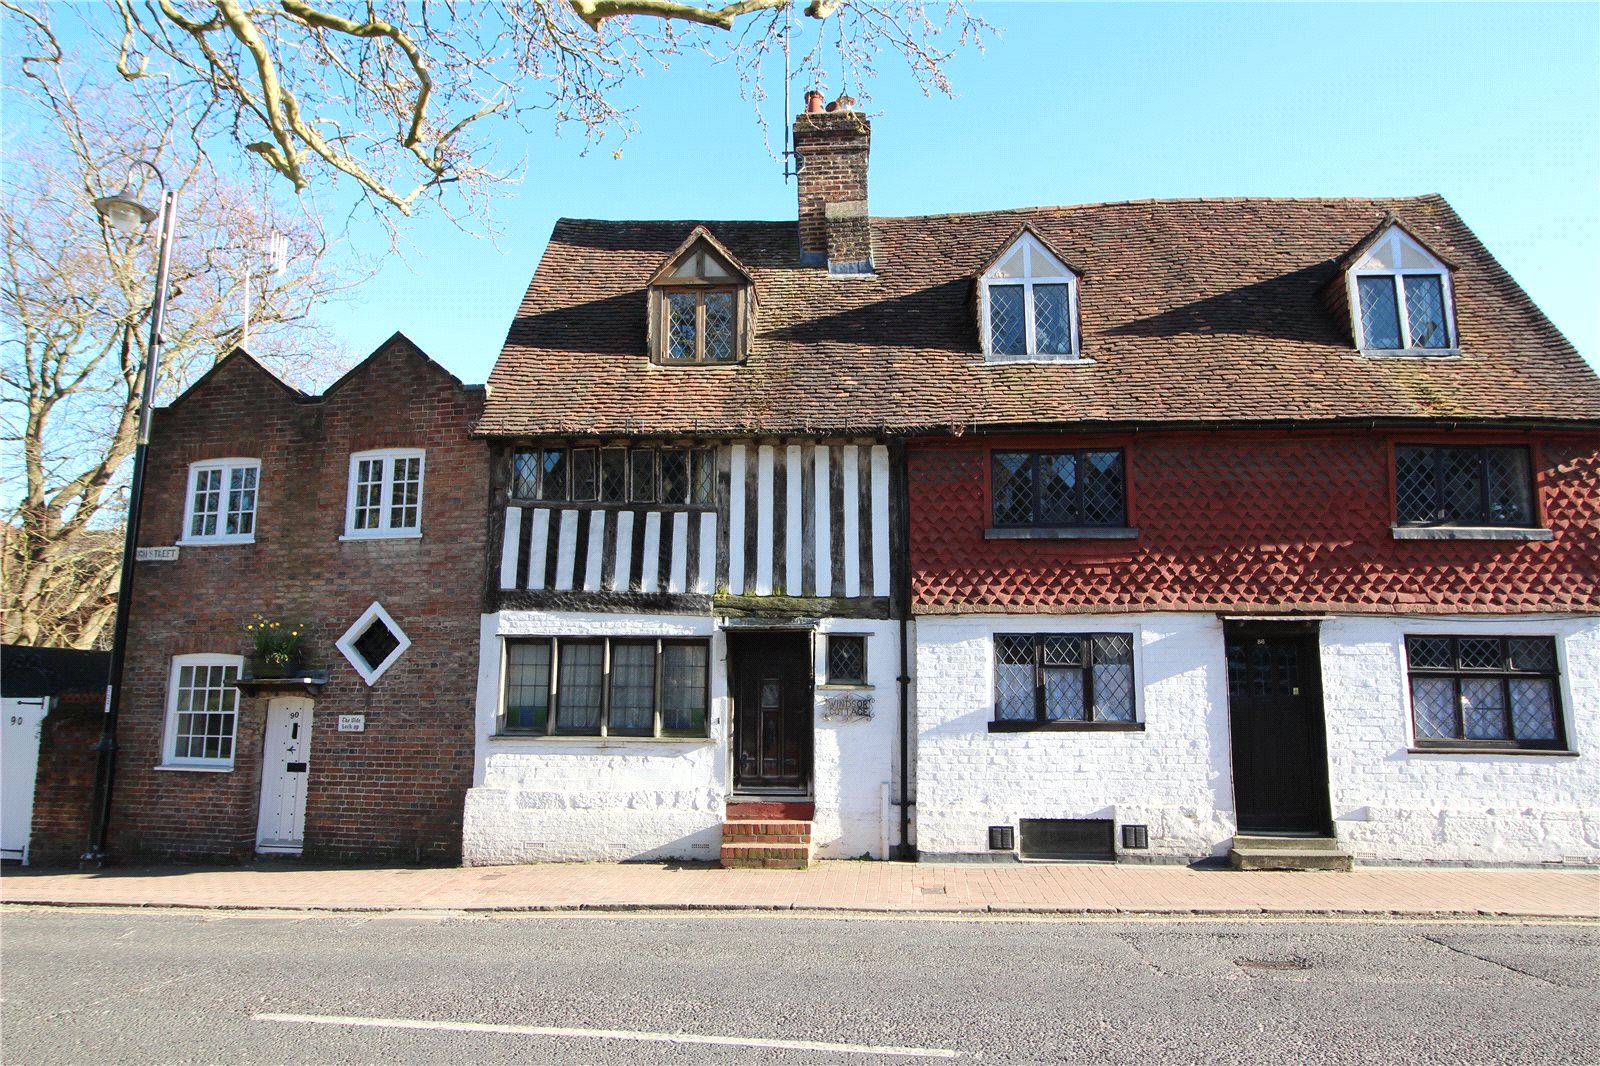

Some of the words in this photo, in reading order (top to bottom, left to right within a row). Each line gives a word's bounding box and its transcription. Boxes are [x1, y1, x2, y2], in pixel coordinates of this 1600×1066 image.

[149, 549, 176, 558] STREET
[828, 699, 868, 709] WINDSOR
[290, 711, 300, 719] 90
[829, 708, 869, 716] COTTAGE
[10, 715, 23, 726] 90
